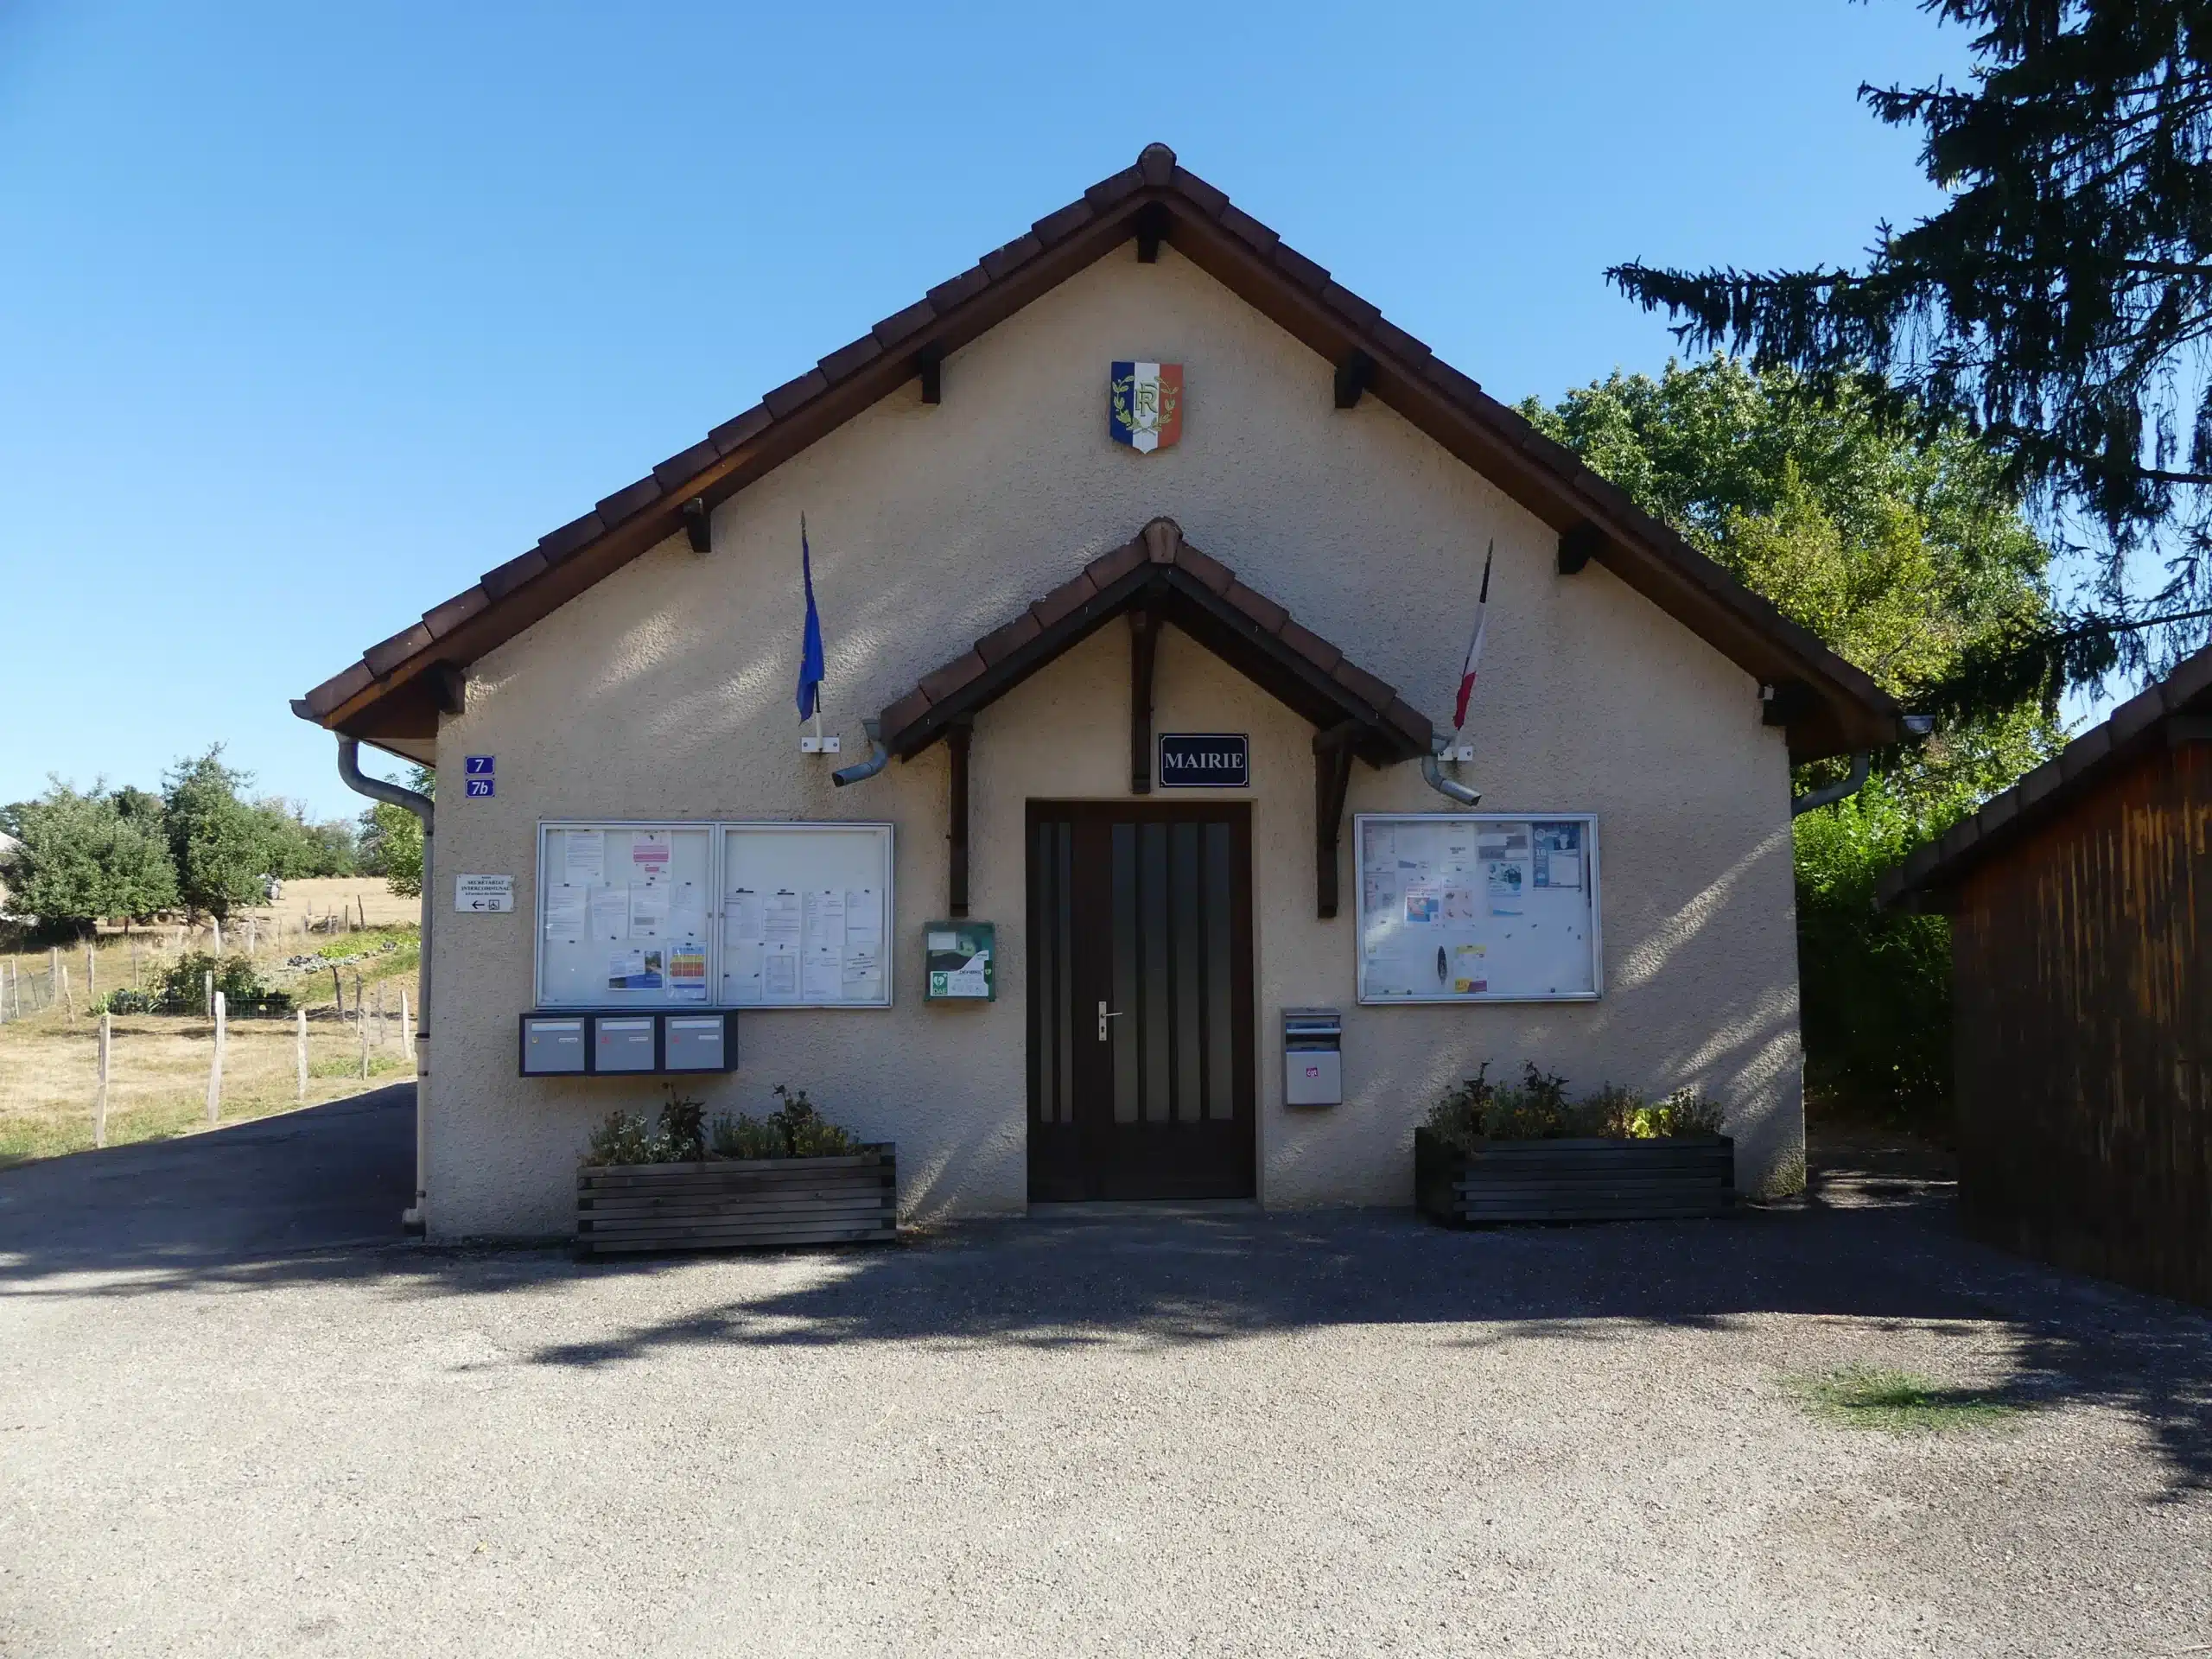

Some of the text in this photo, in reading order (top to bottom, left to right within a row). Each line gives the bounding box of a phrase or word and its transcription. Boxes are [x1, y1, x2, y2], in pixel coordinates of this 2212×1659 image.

[475, 759, 485, 772] 7
[1165, 753, 1244, 769] MAIRIE
[472, 781, 488, 795] 7b
